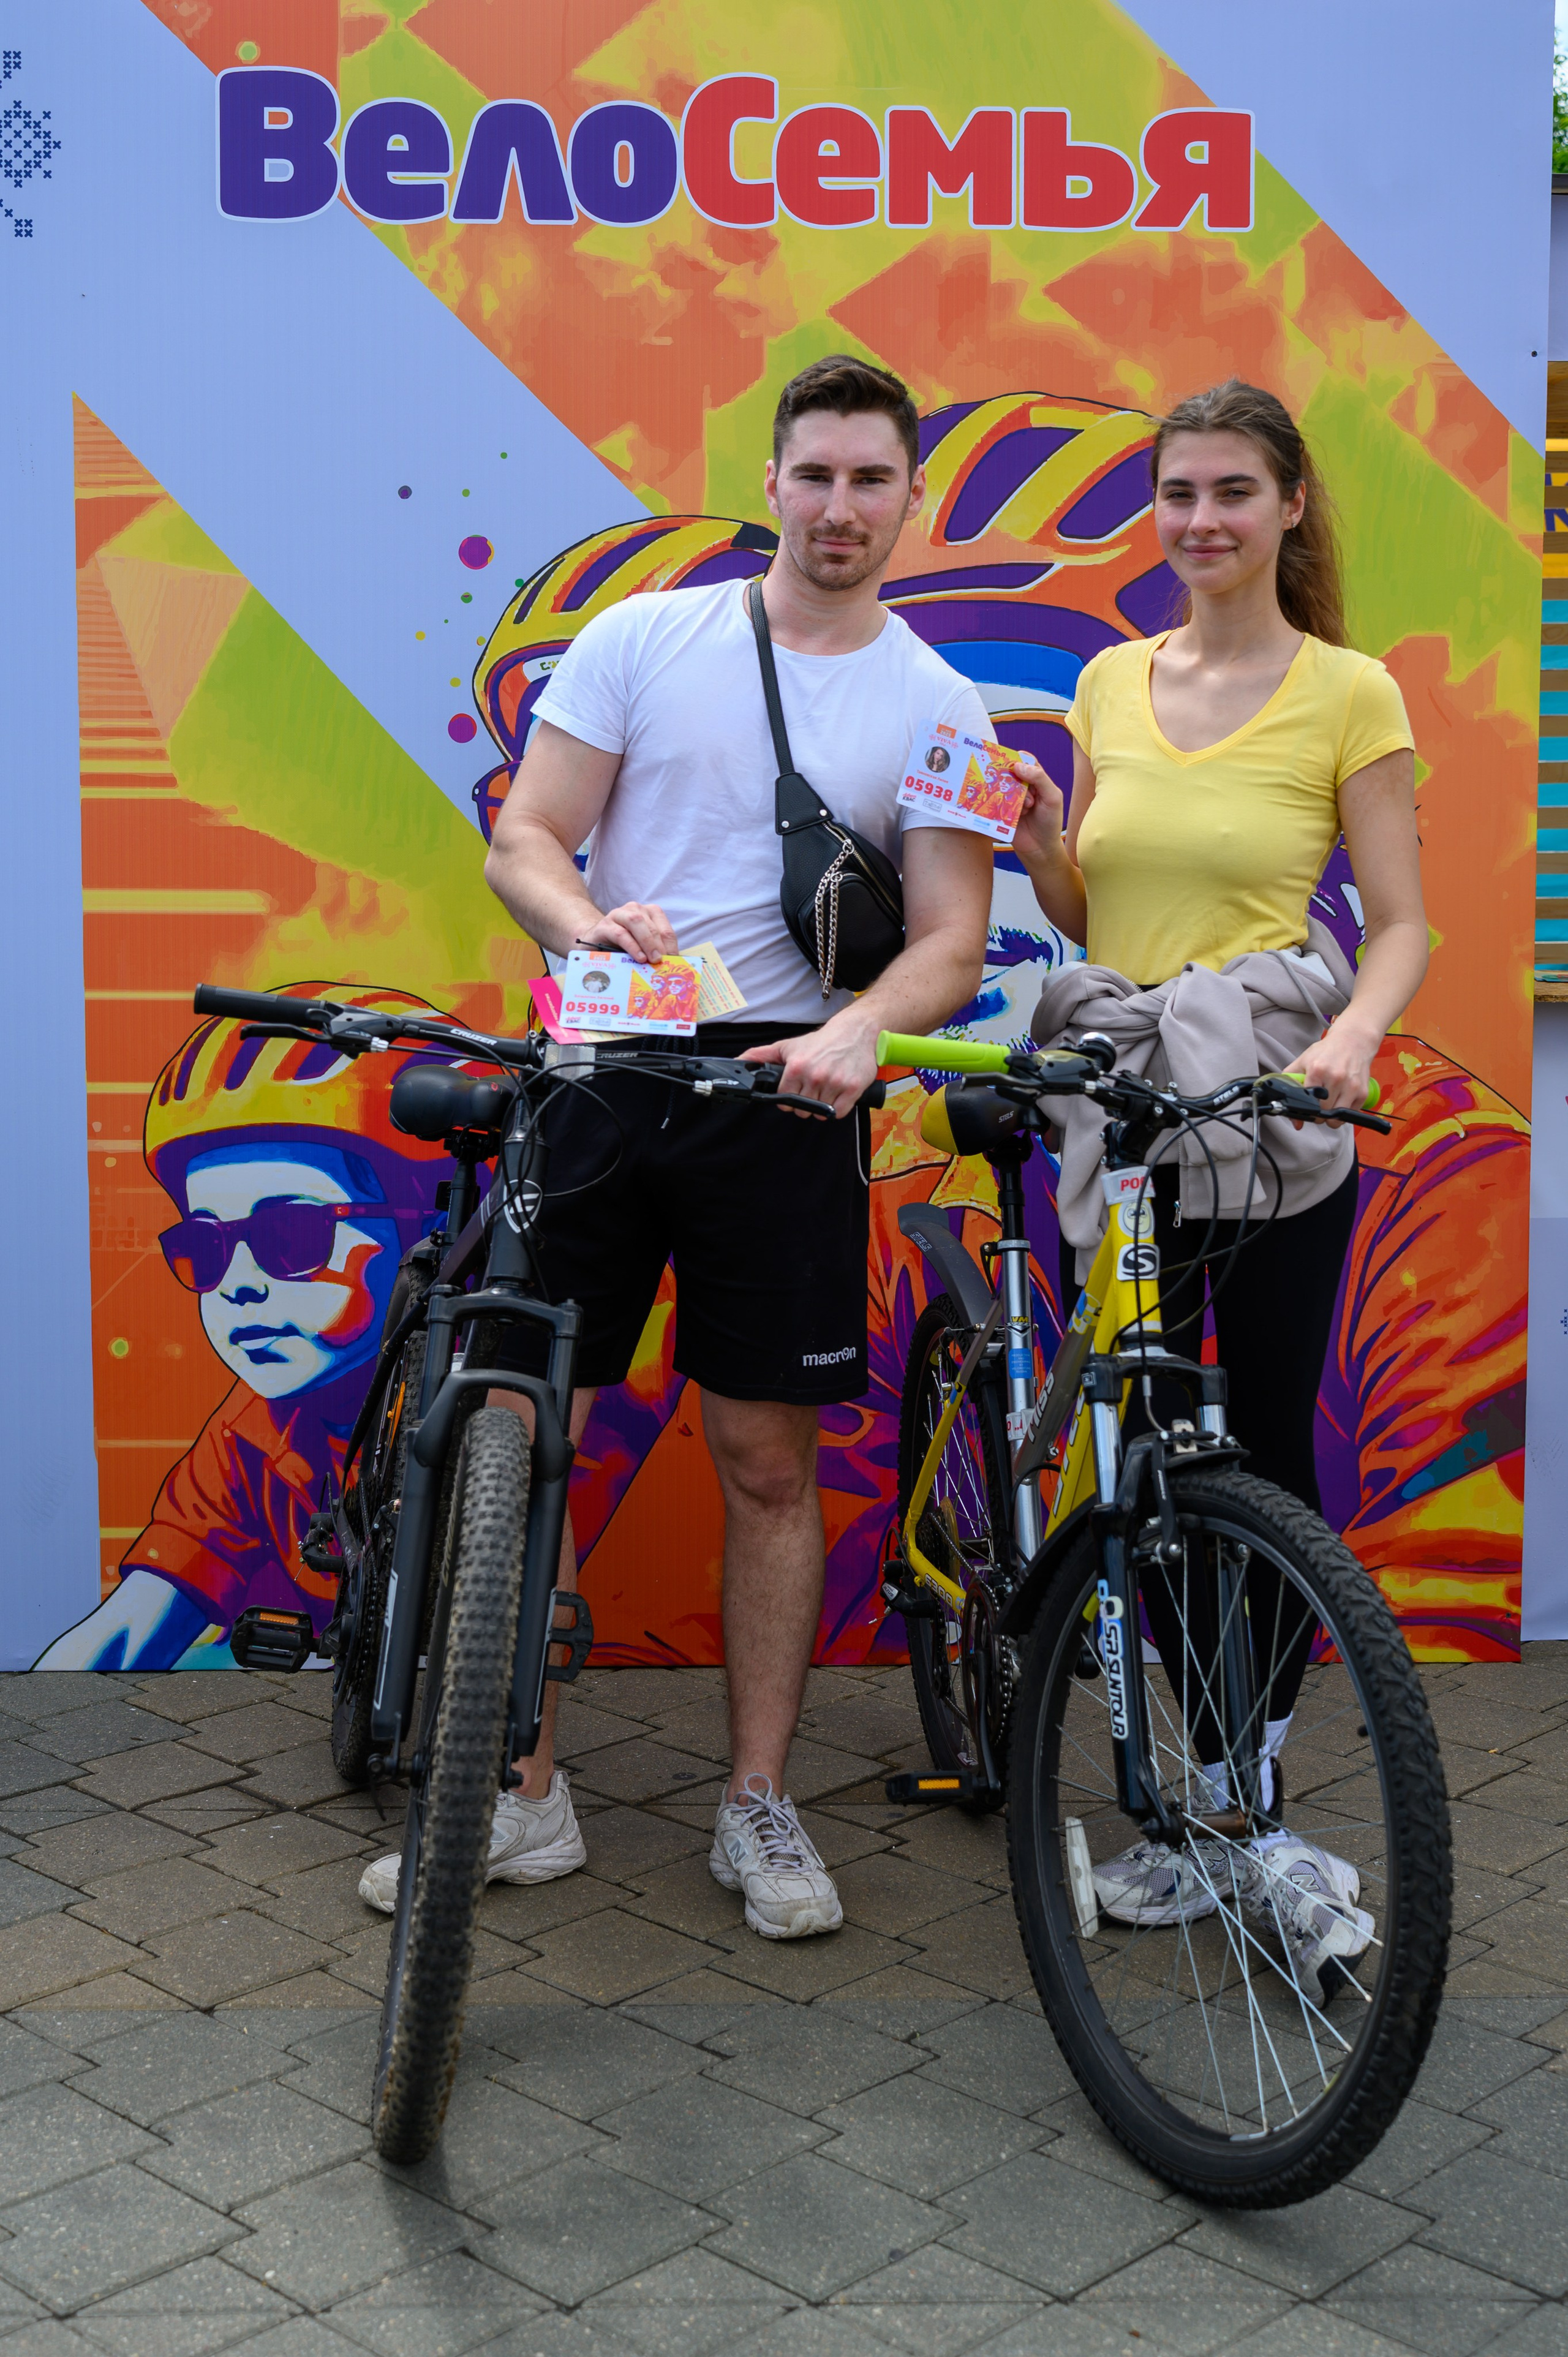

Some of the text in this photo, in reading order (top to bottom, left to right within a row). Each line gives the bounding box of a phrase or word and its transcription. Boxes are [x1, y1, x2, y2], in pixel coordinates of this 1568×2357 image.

[217, 67, 1255, 232] ВелоСемья
[964, 737, 1006, 758] ВелоСемья
[905, 775, 953, 801] 05938
[566, 1001, 620, 1015] 05999
[450, 1028, 497, 1046] CRUZER
[998, 1111, 1014, 1123] STELS
[802, 1347, 856, 1367] macron
[925, 1573, 953, 1608] 6300
[1107, 1656, 1126, 1737] SUNTOUR
